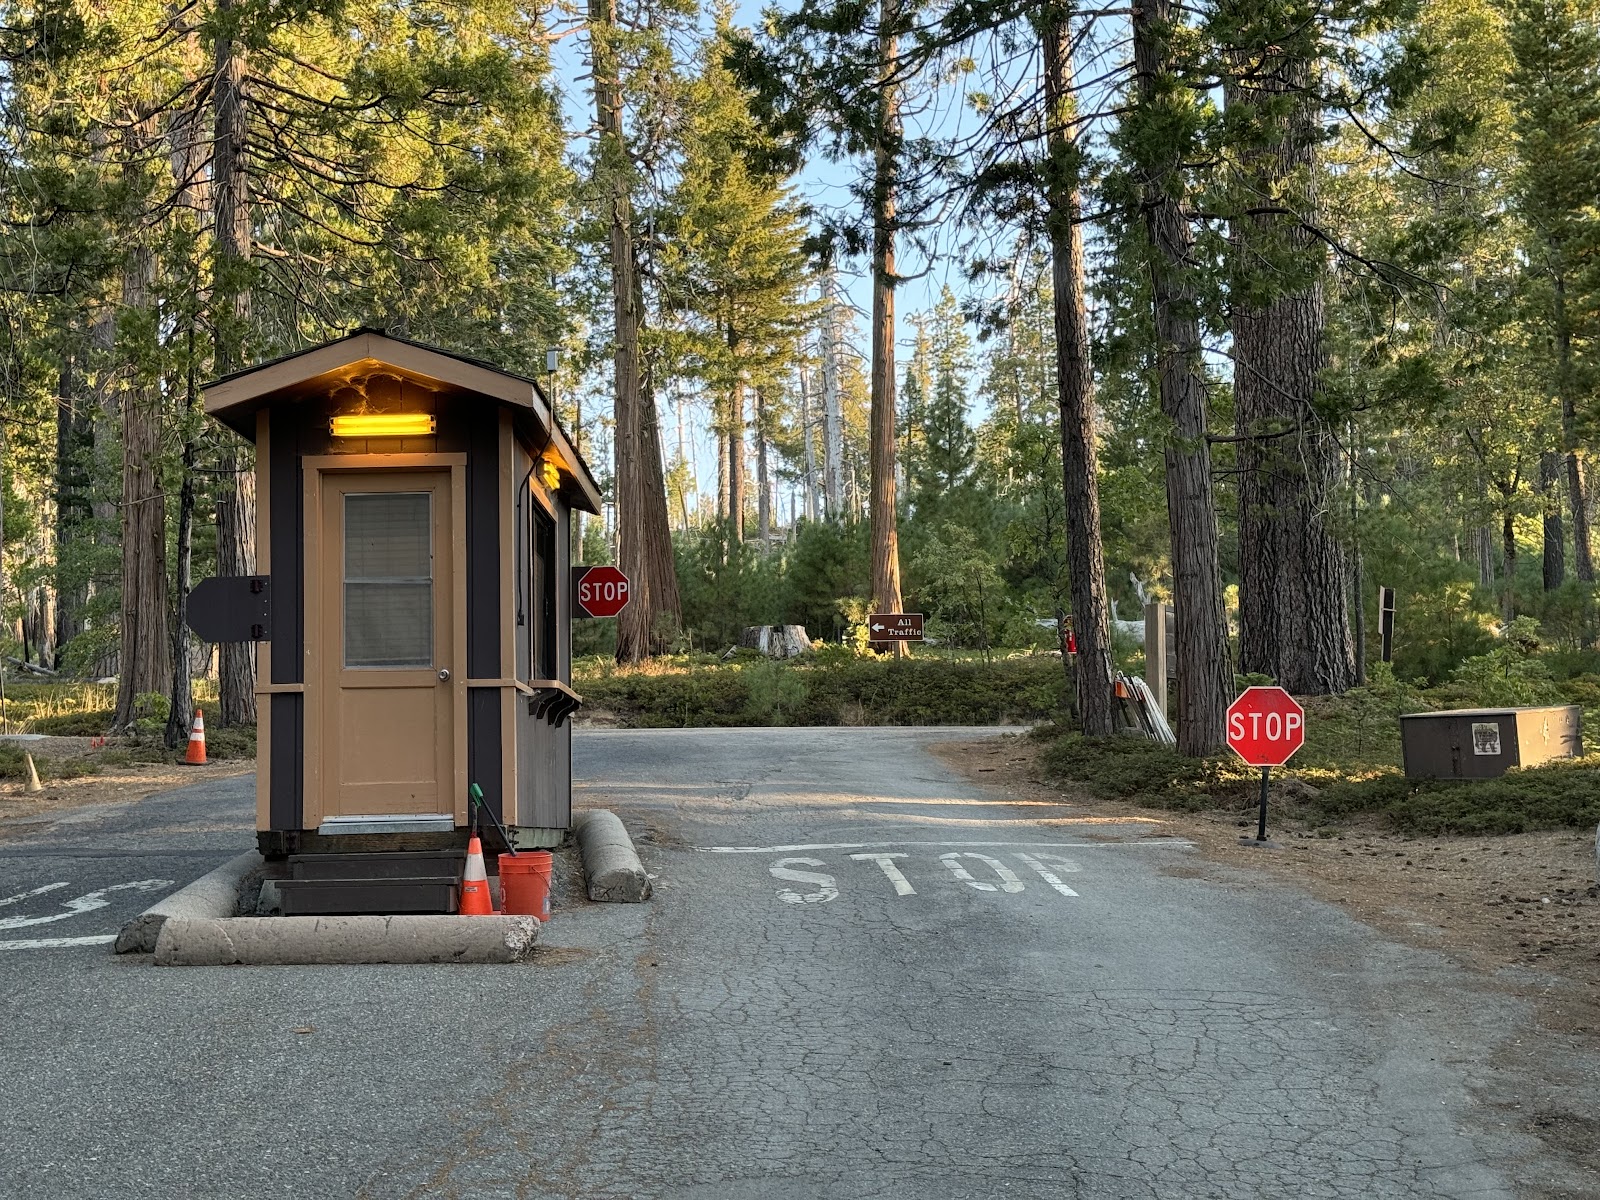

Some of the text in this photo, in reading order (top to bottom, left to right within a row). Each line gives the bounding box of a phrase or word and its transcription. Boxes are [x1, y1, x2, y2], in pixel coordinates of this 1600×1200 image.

[580, 581, 628, 602] STOP
[887, 628, 922, 636] Traffic
[897, 618, 912, 626] All
[1229, 712, 1302, 741] STOP
[769, 852, 1082, 904] STOP
